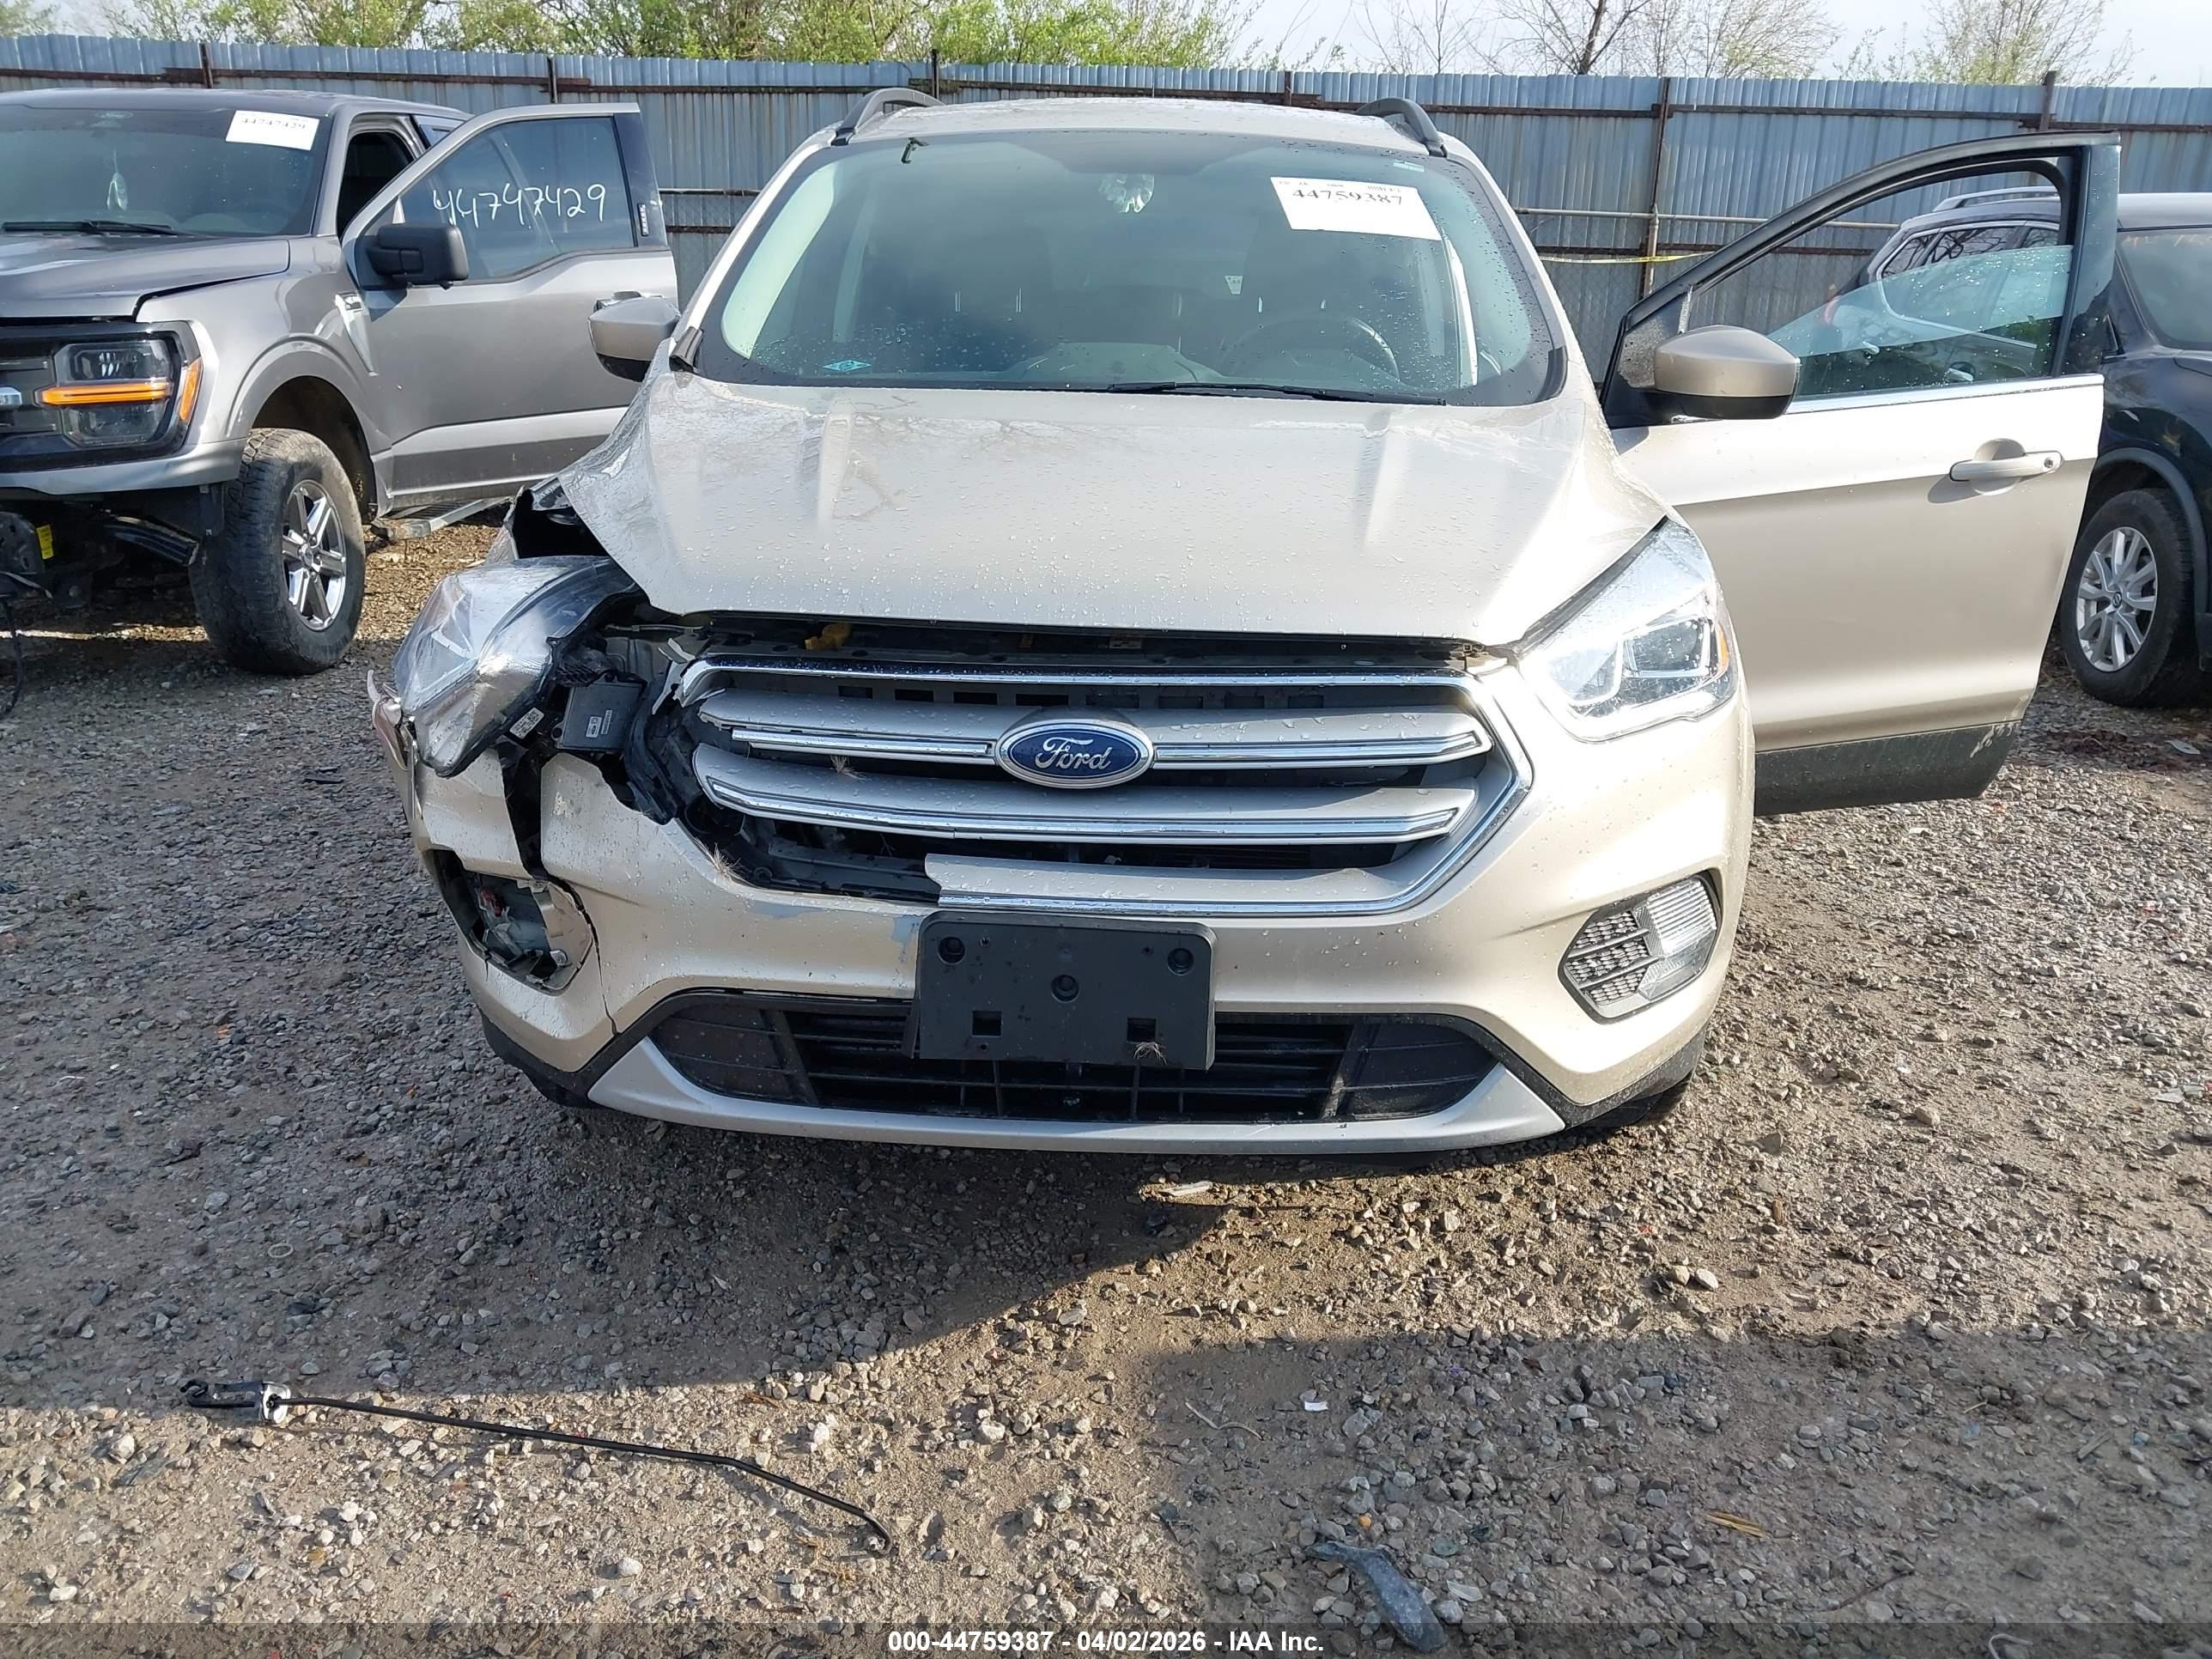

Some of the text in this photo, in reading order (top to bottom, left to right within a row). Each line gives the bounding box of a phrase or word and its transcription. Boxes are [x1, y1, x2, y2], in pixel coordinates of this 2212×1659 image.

[433, 182, 606, 228] 44747429
[1292, 189, 1402, 205] 44759387
[1035, 736, 1113, 770] Ford
